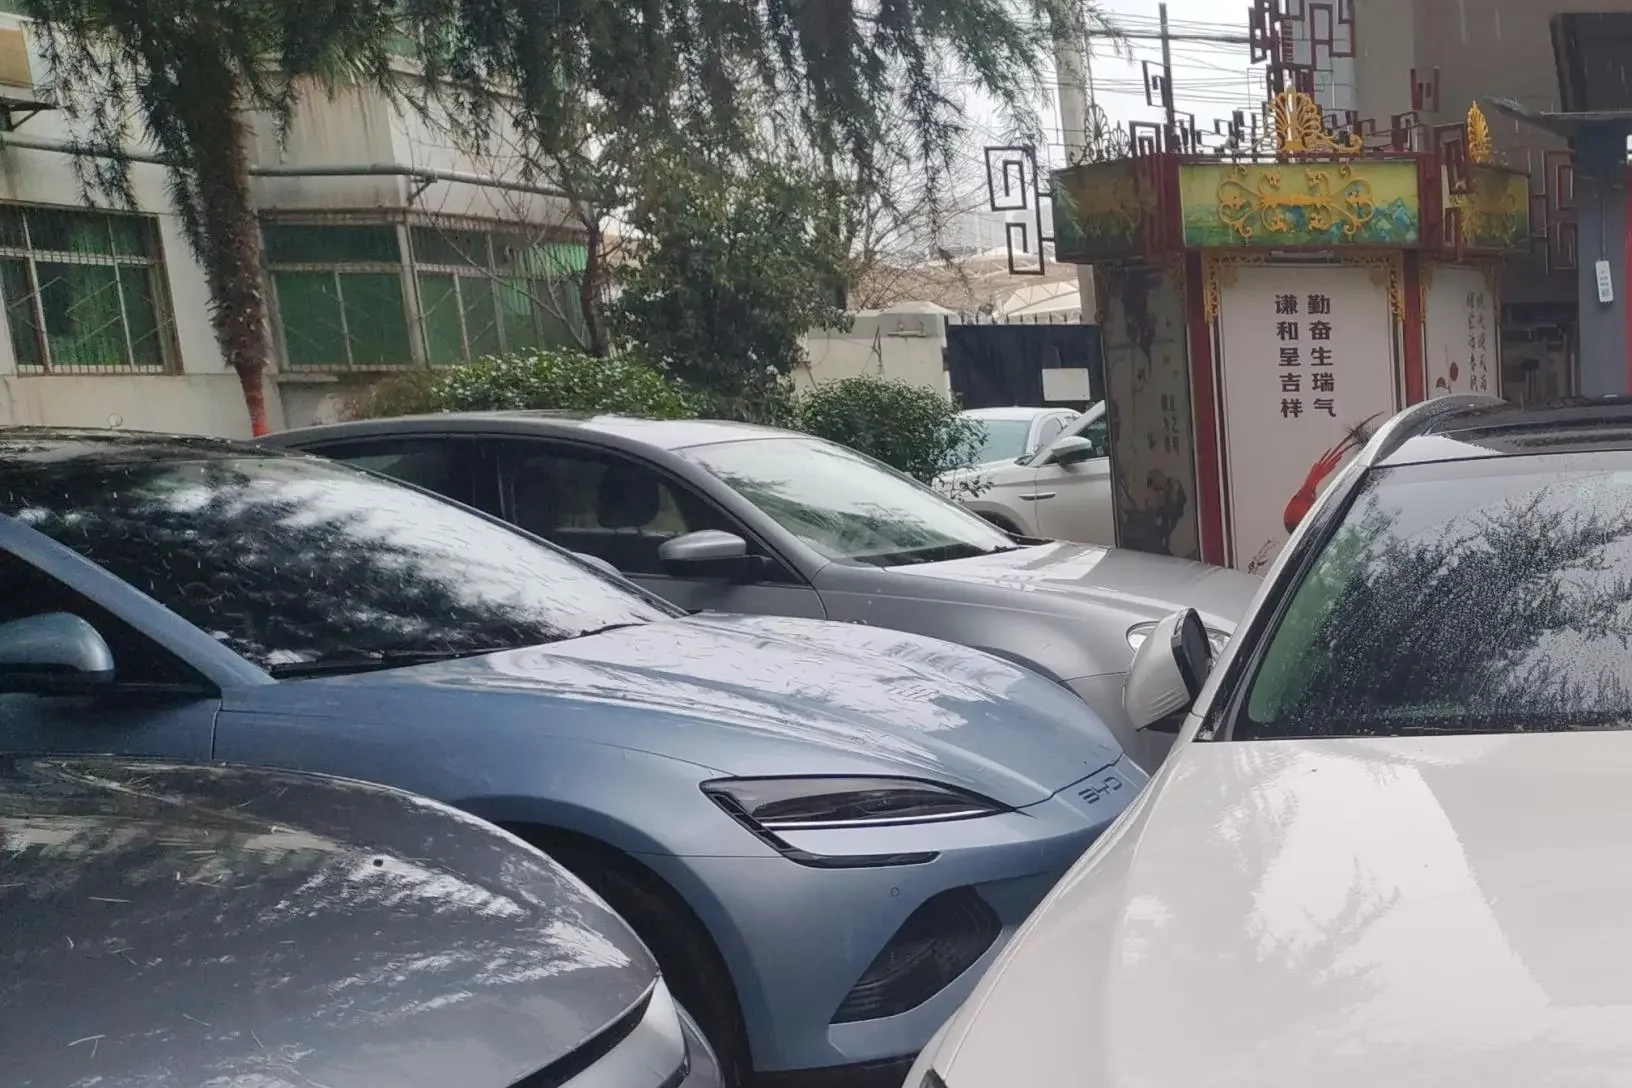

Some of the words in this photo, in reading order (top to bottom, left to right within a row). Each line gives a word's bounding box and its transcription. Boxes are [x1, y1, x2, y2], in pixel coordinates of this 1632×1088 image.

[1307, 294, 1336, 418] 勤奋生瑞气
